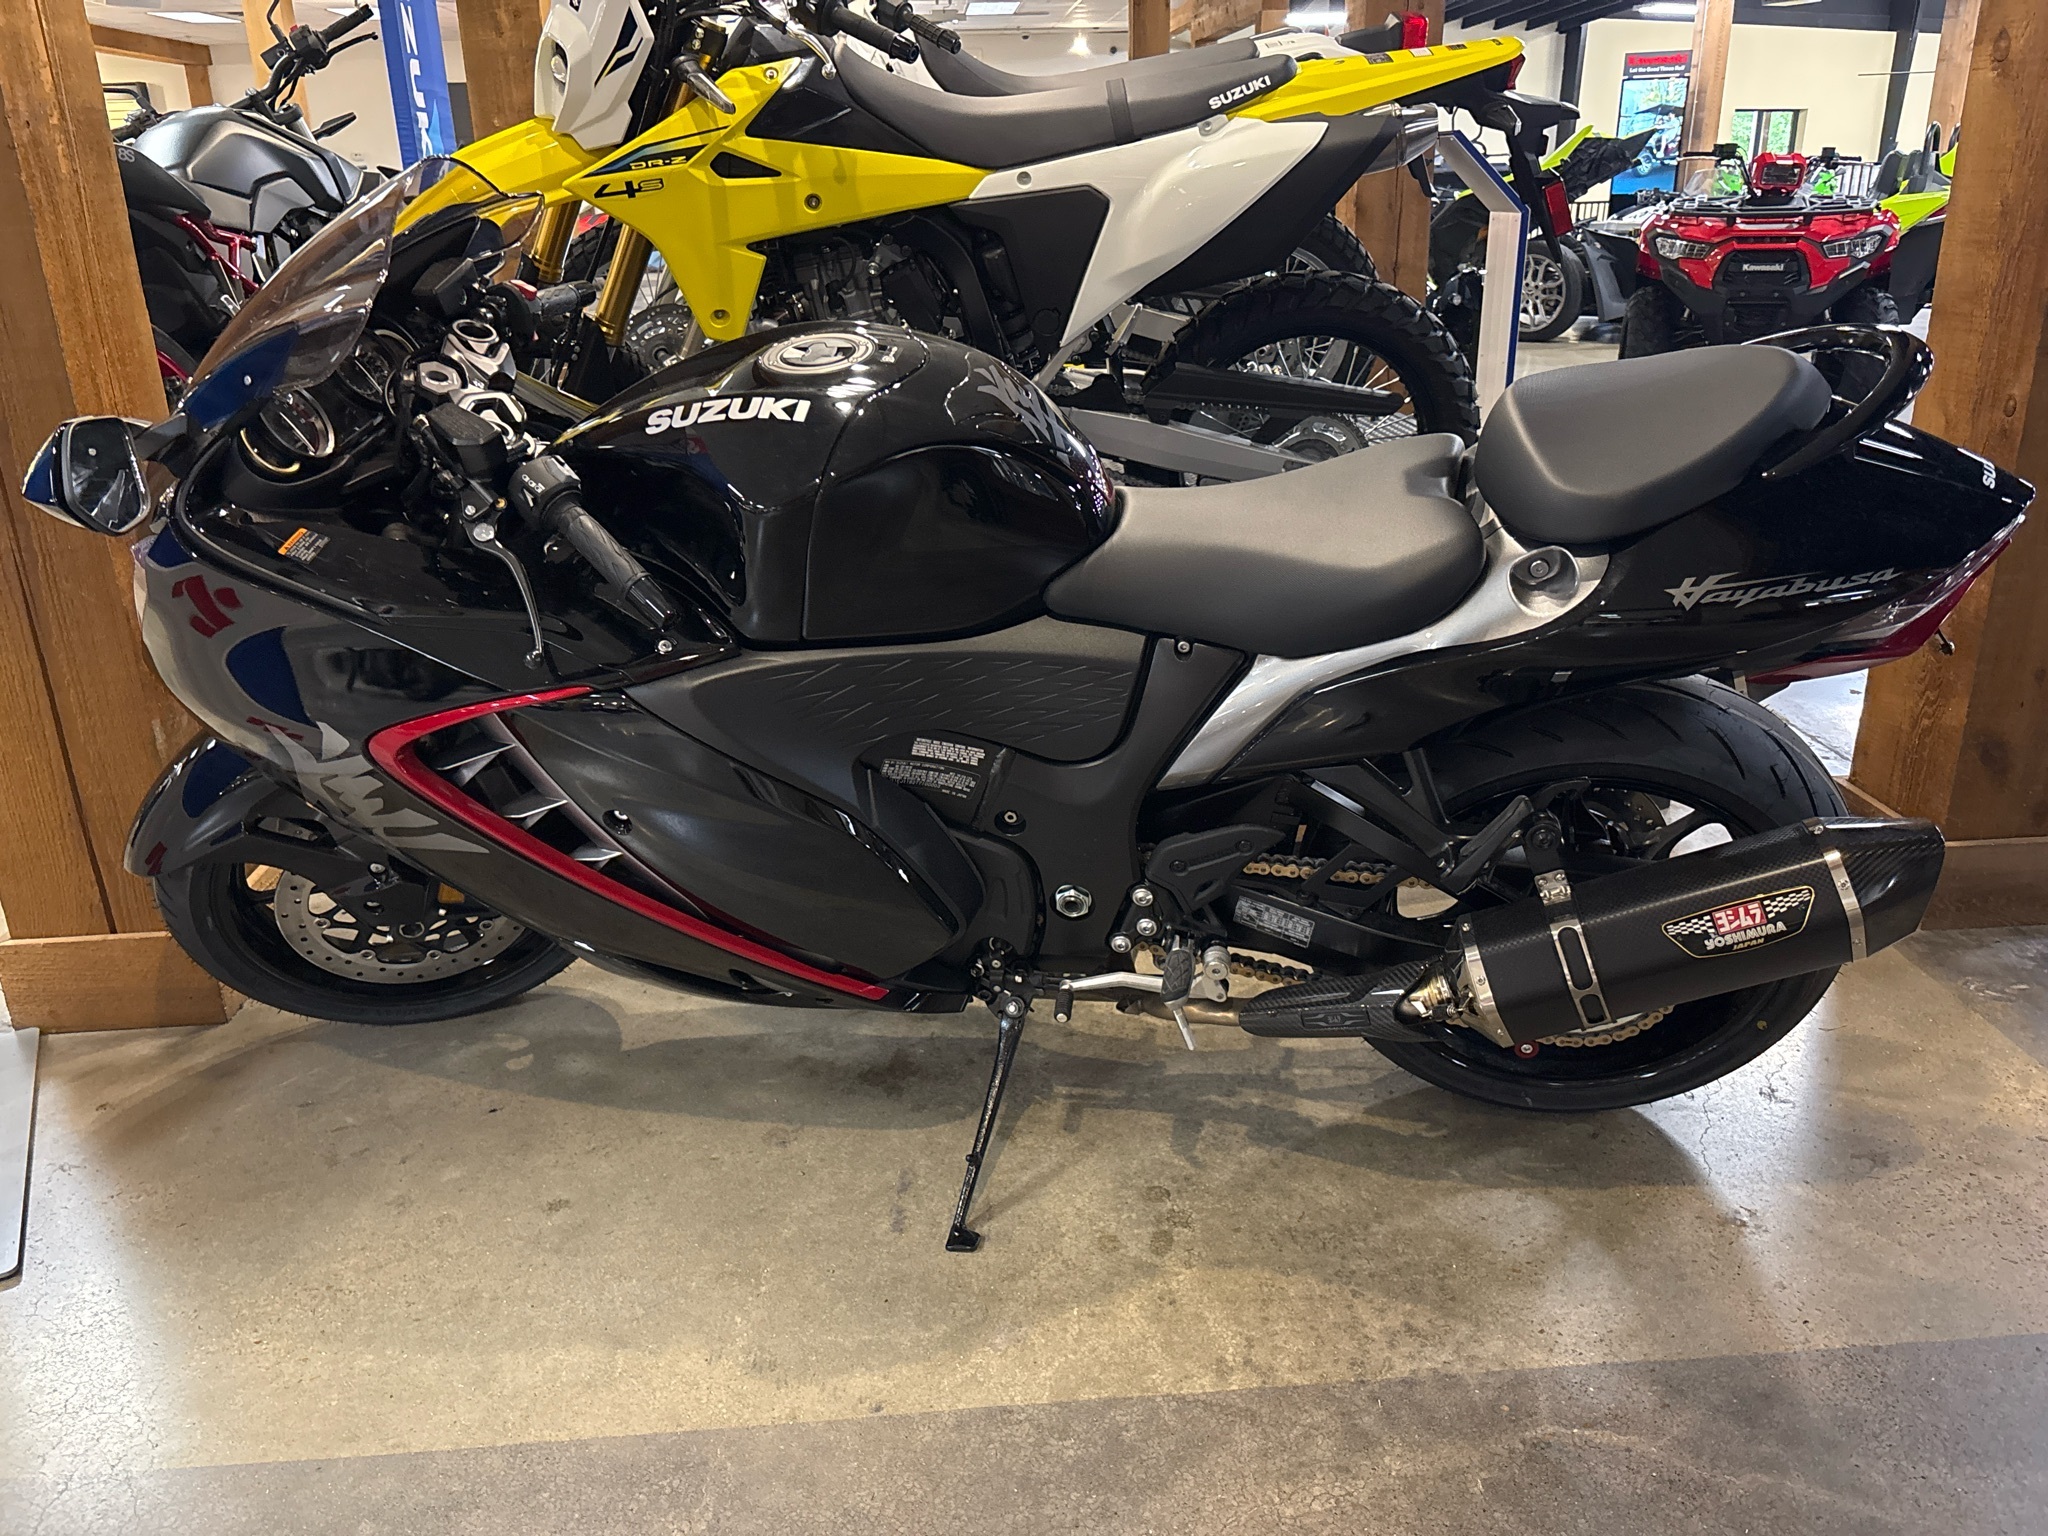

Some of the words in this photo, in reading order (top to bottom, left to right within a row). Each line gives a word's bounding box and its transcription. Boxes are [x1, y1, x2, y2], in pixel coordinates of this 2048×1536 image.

[1208, 74, 1272, 110] SUZUKI
[118, 147, 135, 162] 8S
[629, 155, 687, 170] DR-Z
[645, 396, 812, 435] SUZUKI
[1664, 567, 1903, 611] Hayabusa
[1713, 901, 1766, 934] ヨシムラ
[1703, 920, 1788, 951] YOSHIMURA
[1731, 937, 1765, 951] JAPAN
